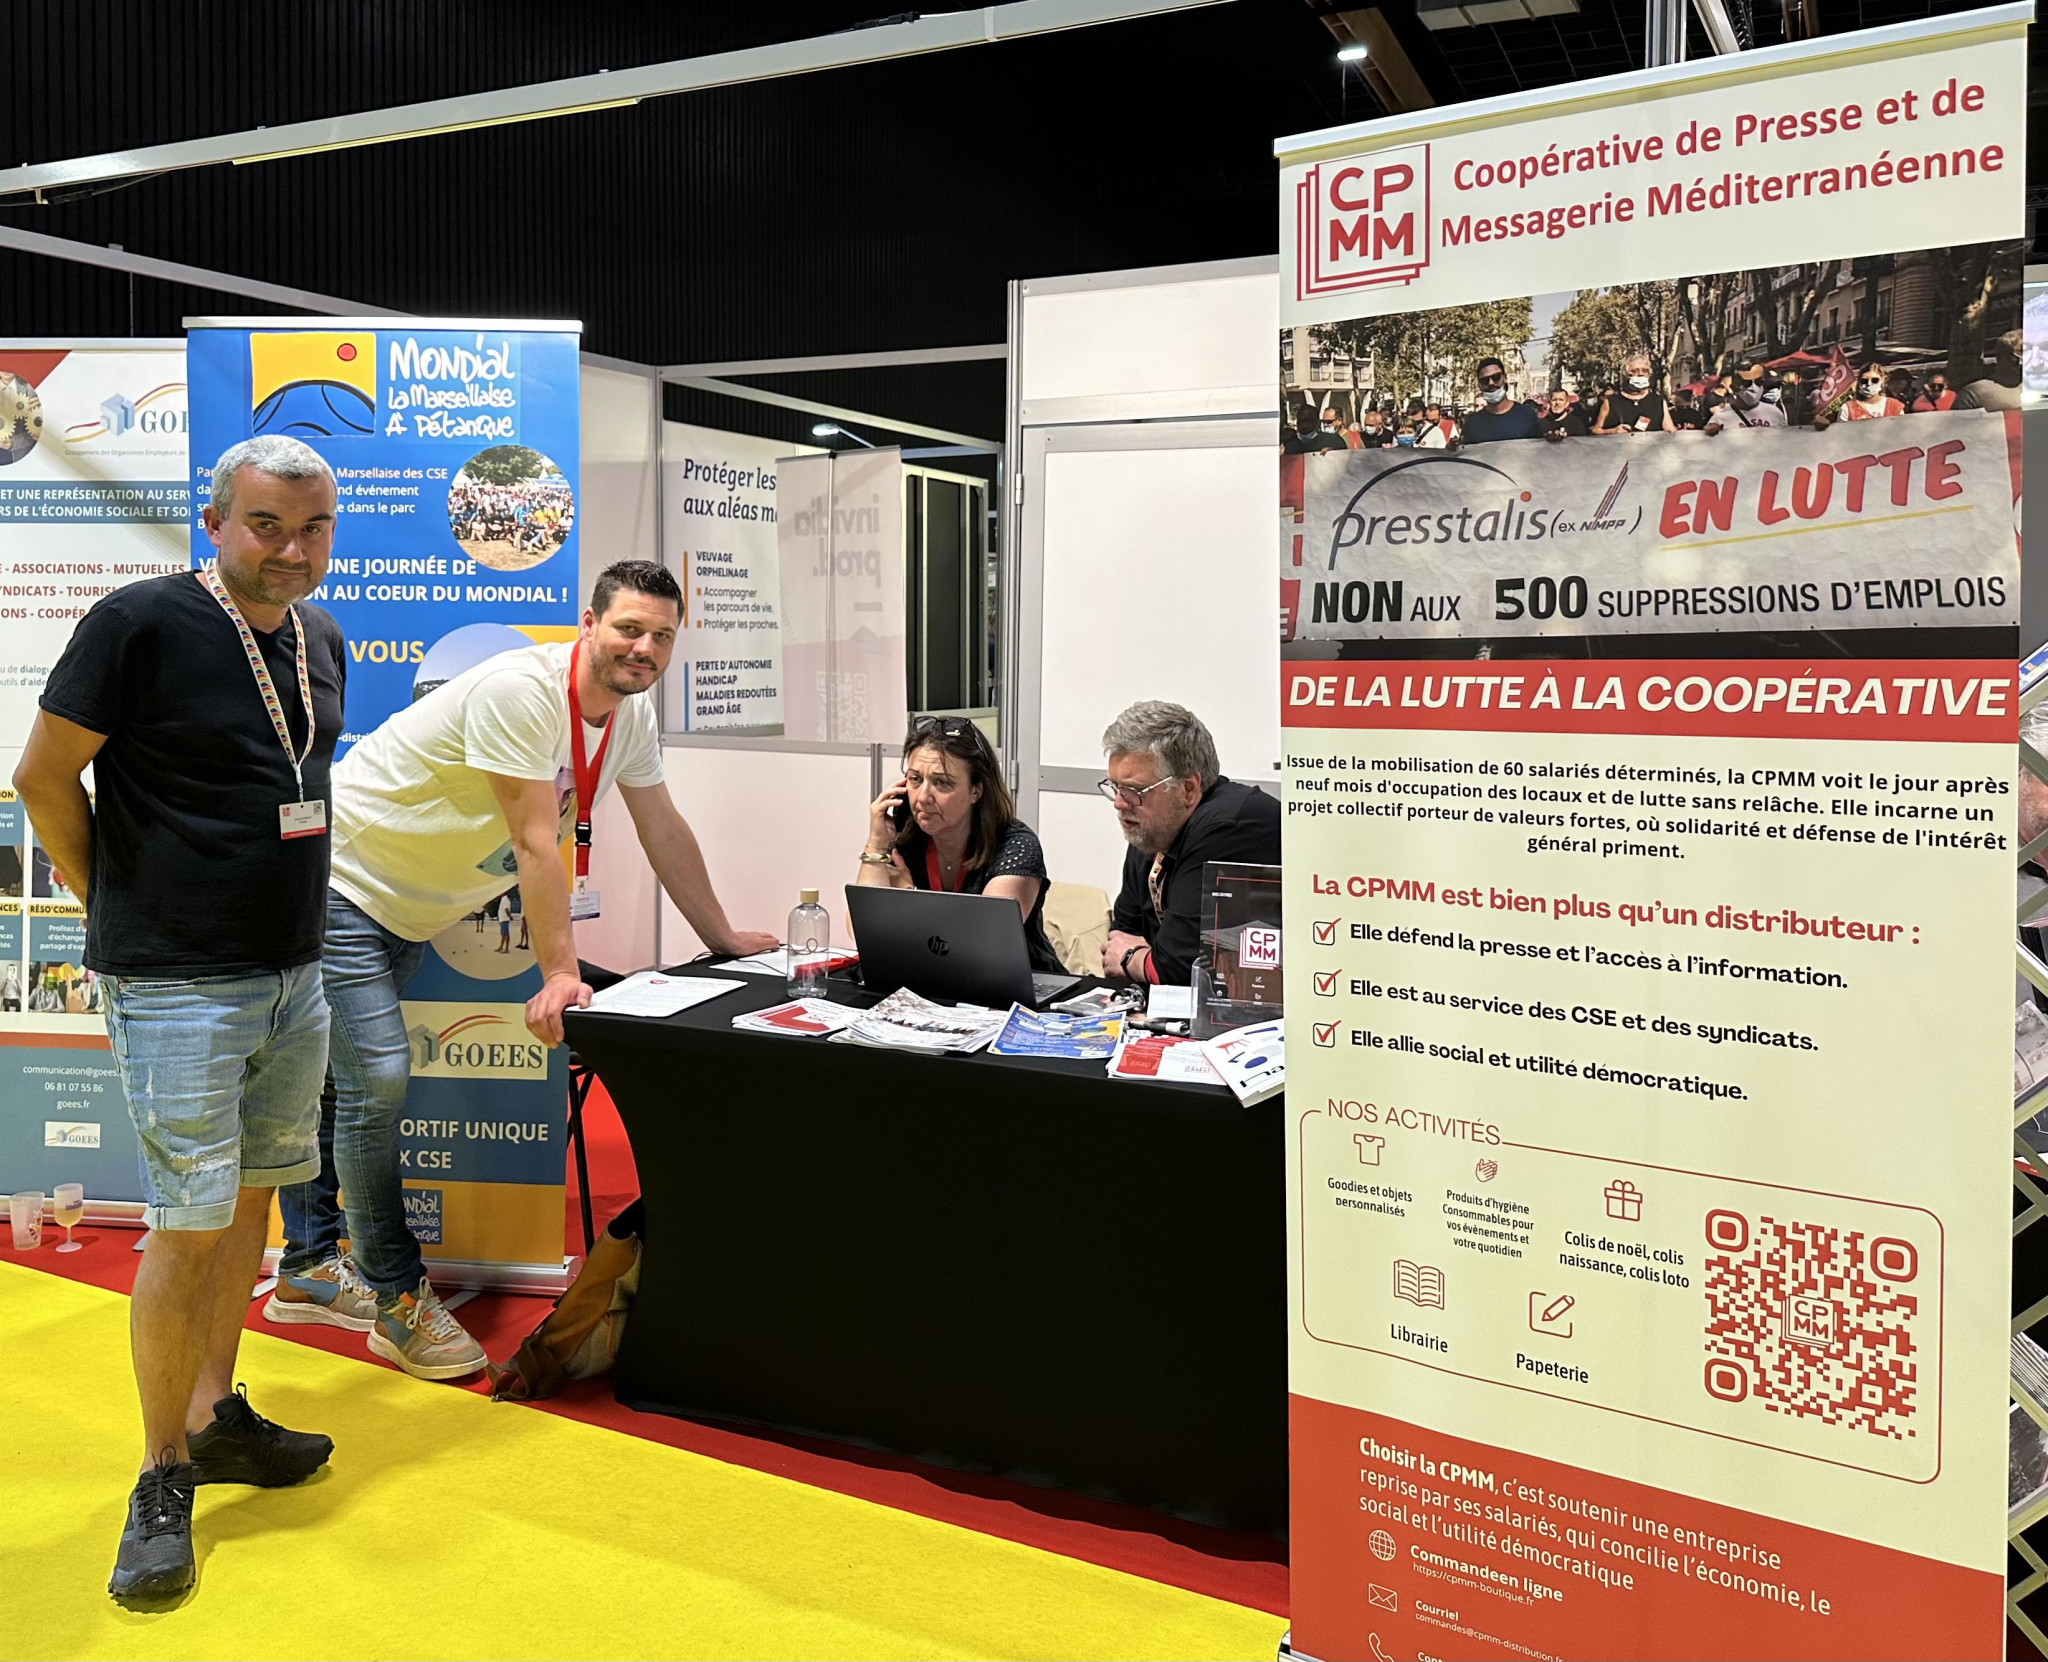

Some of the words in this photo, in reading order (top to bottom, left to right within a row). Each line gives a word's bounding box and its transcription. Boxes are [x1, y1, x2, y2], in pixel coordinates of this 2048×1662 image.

[1454, 133, 1664, 191] Coopérative
[1675, 120, 1722, 155] de
[1735, 103, 1862, 147] Presse
[1876, 90, 1919, 125] et
[1932, 78, 1985, 117] de
[1441, 192, 1635, 248] Messagerie
[1647, 144, 2004, 218] Méditerranéenne
[336, 467, 401, 479] Marsellaise
[403, 467, 424, 479] des
[426, 468, 448, 480] CSE
[683, 457, 754, 492] Protéger
[756, 467, 777, 491] les
[1, 489, 13, 500] ET
[16, 489, 41, 500] UNE
[44, 487, 144, 501] REPRÉSENTATION
[147, 489, 164, 500] AU
[356, 484, 419, 497] événement
[1659, 476, 1739, 539] EN
[1757, 439, 1966, 526] LUTTE
[14, 505, 29, 517] DE
[32, 503, 103, 517] L'ÉCONOMIE
[106, 506, 153, 517] SOCIALE
[157, 506, 170, 517] ET
[347, 502, 375, 514] dans
[378, 502, 388, 514] le
[390, 503, 416, 516] parc
[683, 496, 715, 518] aux
[717, 496, 758, 521] aléas
[1328, 490, 1549, 571] presstalis
[362, 555, 447, 578] JOURNÉE
[452, 560, 477, 575] DE
[696, 551, 733, 563] VEUVAGE
[12, 563, 104, 574] ASSOCIATIONS
[113, 563, 185, 575] MUTUELLES
[696, 566, 749, 579] ORPHELINAGE
[333, 585, 360, 601] AU
[366, 585, 428, 602] COEUR
[433, 586, 460, 602] DU
[466, 586, 557, 603] MONDIAL
[704, 586, 757, 602] Accompagner
[1311, 580, 1403, 624] NON
[1409, 595, 1462, 621] AUX
[1494, 575, 1589, 621] 500
[1597, 583, 1820, 618] SUPPRESSIONS
[704, 601, 715, 613] les
[716, 603, 750, 616] parcours
[751, 602, 761, 613] de
[762, 602, 774, 613] vie.
[704, 618, 737, 632] Protéger
[737, 618, 748, 630] les
[749, 619, 779, 633] proches.
[348, 640, 425, 664] VOUS
[696, 661, 720, 671] PERTE
[696, 675, 738, 686] HANDICAP
[1289, 676, 1338, 707] DE
[1344, 676, 1393, 708] LA
[1400, 676, 1526, 710] LUTTE
[1529, 667, 1563, 710] À
[1571, 677, 1627, 711] LA
[1637, 668, 2012, 716] COOPÉRATIVE
[696, 689, 736, 702] MALADIES
[736, 685, 777, 700] REDOUTÉES
[696, 704, 725, 716] GRAND
[726, 701, 742, 715] ÂGE
[1312, 873, 1342, 896] La
[1346, 876, 1435, 903] CPMM
[1441, 887, 1484, 908] est
[1489, 886, 1547, 914] bien
[1553, 893, 1612, 921] plus
[1704, 904, 1904, 943] distributeur
[444, 1042, 543, 1069] GOEES
[45, 1081, 55, 1091] 06
[57, 1082, 66, 1091] 81
[69, 1082, 79, 1092] 07
[81, 1083, 92, 1093] 55
[93, 1083, 104, 1093] 86
[57, 1100, 91, 1110] goees.fr
[466, 1120, 549, 1144] UNIQUE
[1327, 1098, 1379, 1124] NOS
[1384, 1106, 1502, 1147] ACTIVITÉS
[69, 1134, 99, 1144] GOEES
[416, 1150, 452, 1169] CSE
[1327, 1177, 1369, 1195] Goodies
[1370, 1184, 1381, 1197] et
[1381, 1185, 1413, 1203] objets
[1446, 1189, 1483, 1207] Produits
[1335, 1196, 1406, 1218] personnalisés
[1442, 1203, 1511, 1225] Consommables
[1512, 1217, 1535, 1232] pour
[1446, 1221, 1461, 1232] vos
[1519, 1234, 1530, 1245] et
[1453, 1236, 1477, 1250] votre
[1477, 1241, 1523, 1259] quotidien
[1564, 1230, 1596, 1249] Colis
[1598, 1236, 1615, 1253] de
[1616, 1243, 1651, 1261] noël,
[1652, 1248, 1685, 1266] colis
[1559, 1252, 1628, 1278] naissance,
[1629, 1265, 1661, 1283] colis
[1662, 1269, 1691, 1289] loto
[1390, 1323, 1449, 1353] Librairie
[1515, 1352, 1590, 1384] Papeterie
[1412, 1561, 1535, 1608] https://cpmm-boutique.fr
[1522, 1576, 1565, 1603] ligne
[1415, 1599, 1460, 1622] Courriel
